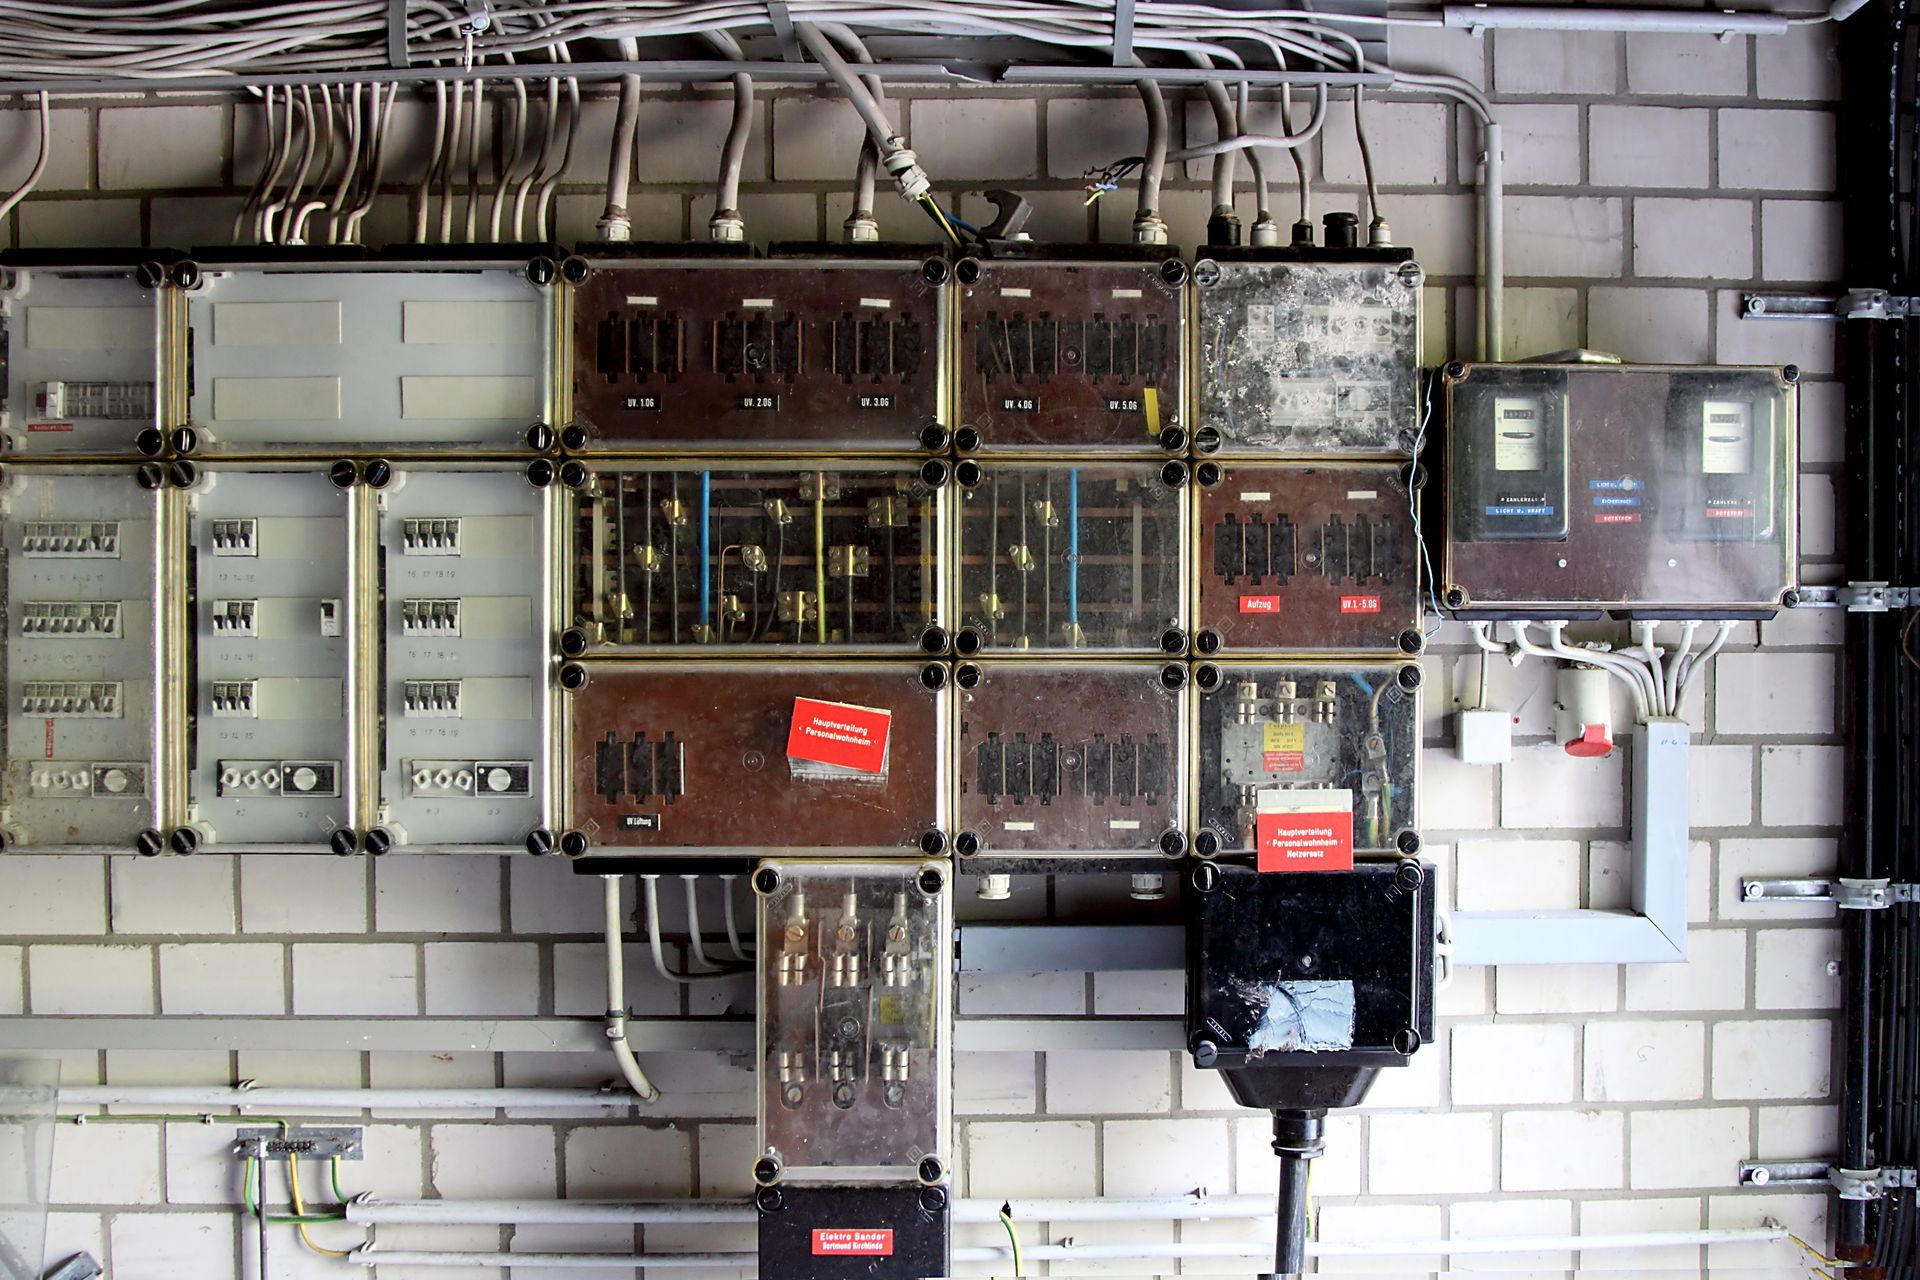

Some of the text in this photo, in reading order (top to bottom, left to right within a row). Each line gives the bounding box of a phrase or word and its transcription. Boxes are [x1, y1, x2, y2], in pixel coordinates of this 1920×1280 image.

[1247, 599, 1272, 610] Aufzug
[813, 716, 868, 736] Hauptverteilung
[805, 726, 871, 746] Personalwohnheim
[1277, 827, 1333, 837] Hauptverteilung
[1272, 838, 1338, 848] Personalwohnheim
[1286, 849, 1324, 858] Netzersatz
[820, 1232, 886, 1241] Elektro Sander
[822, 1241, 852, 1250] Dortmund
